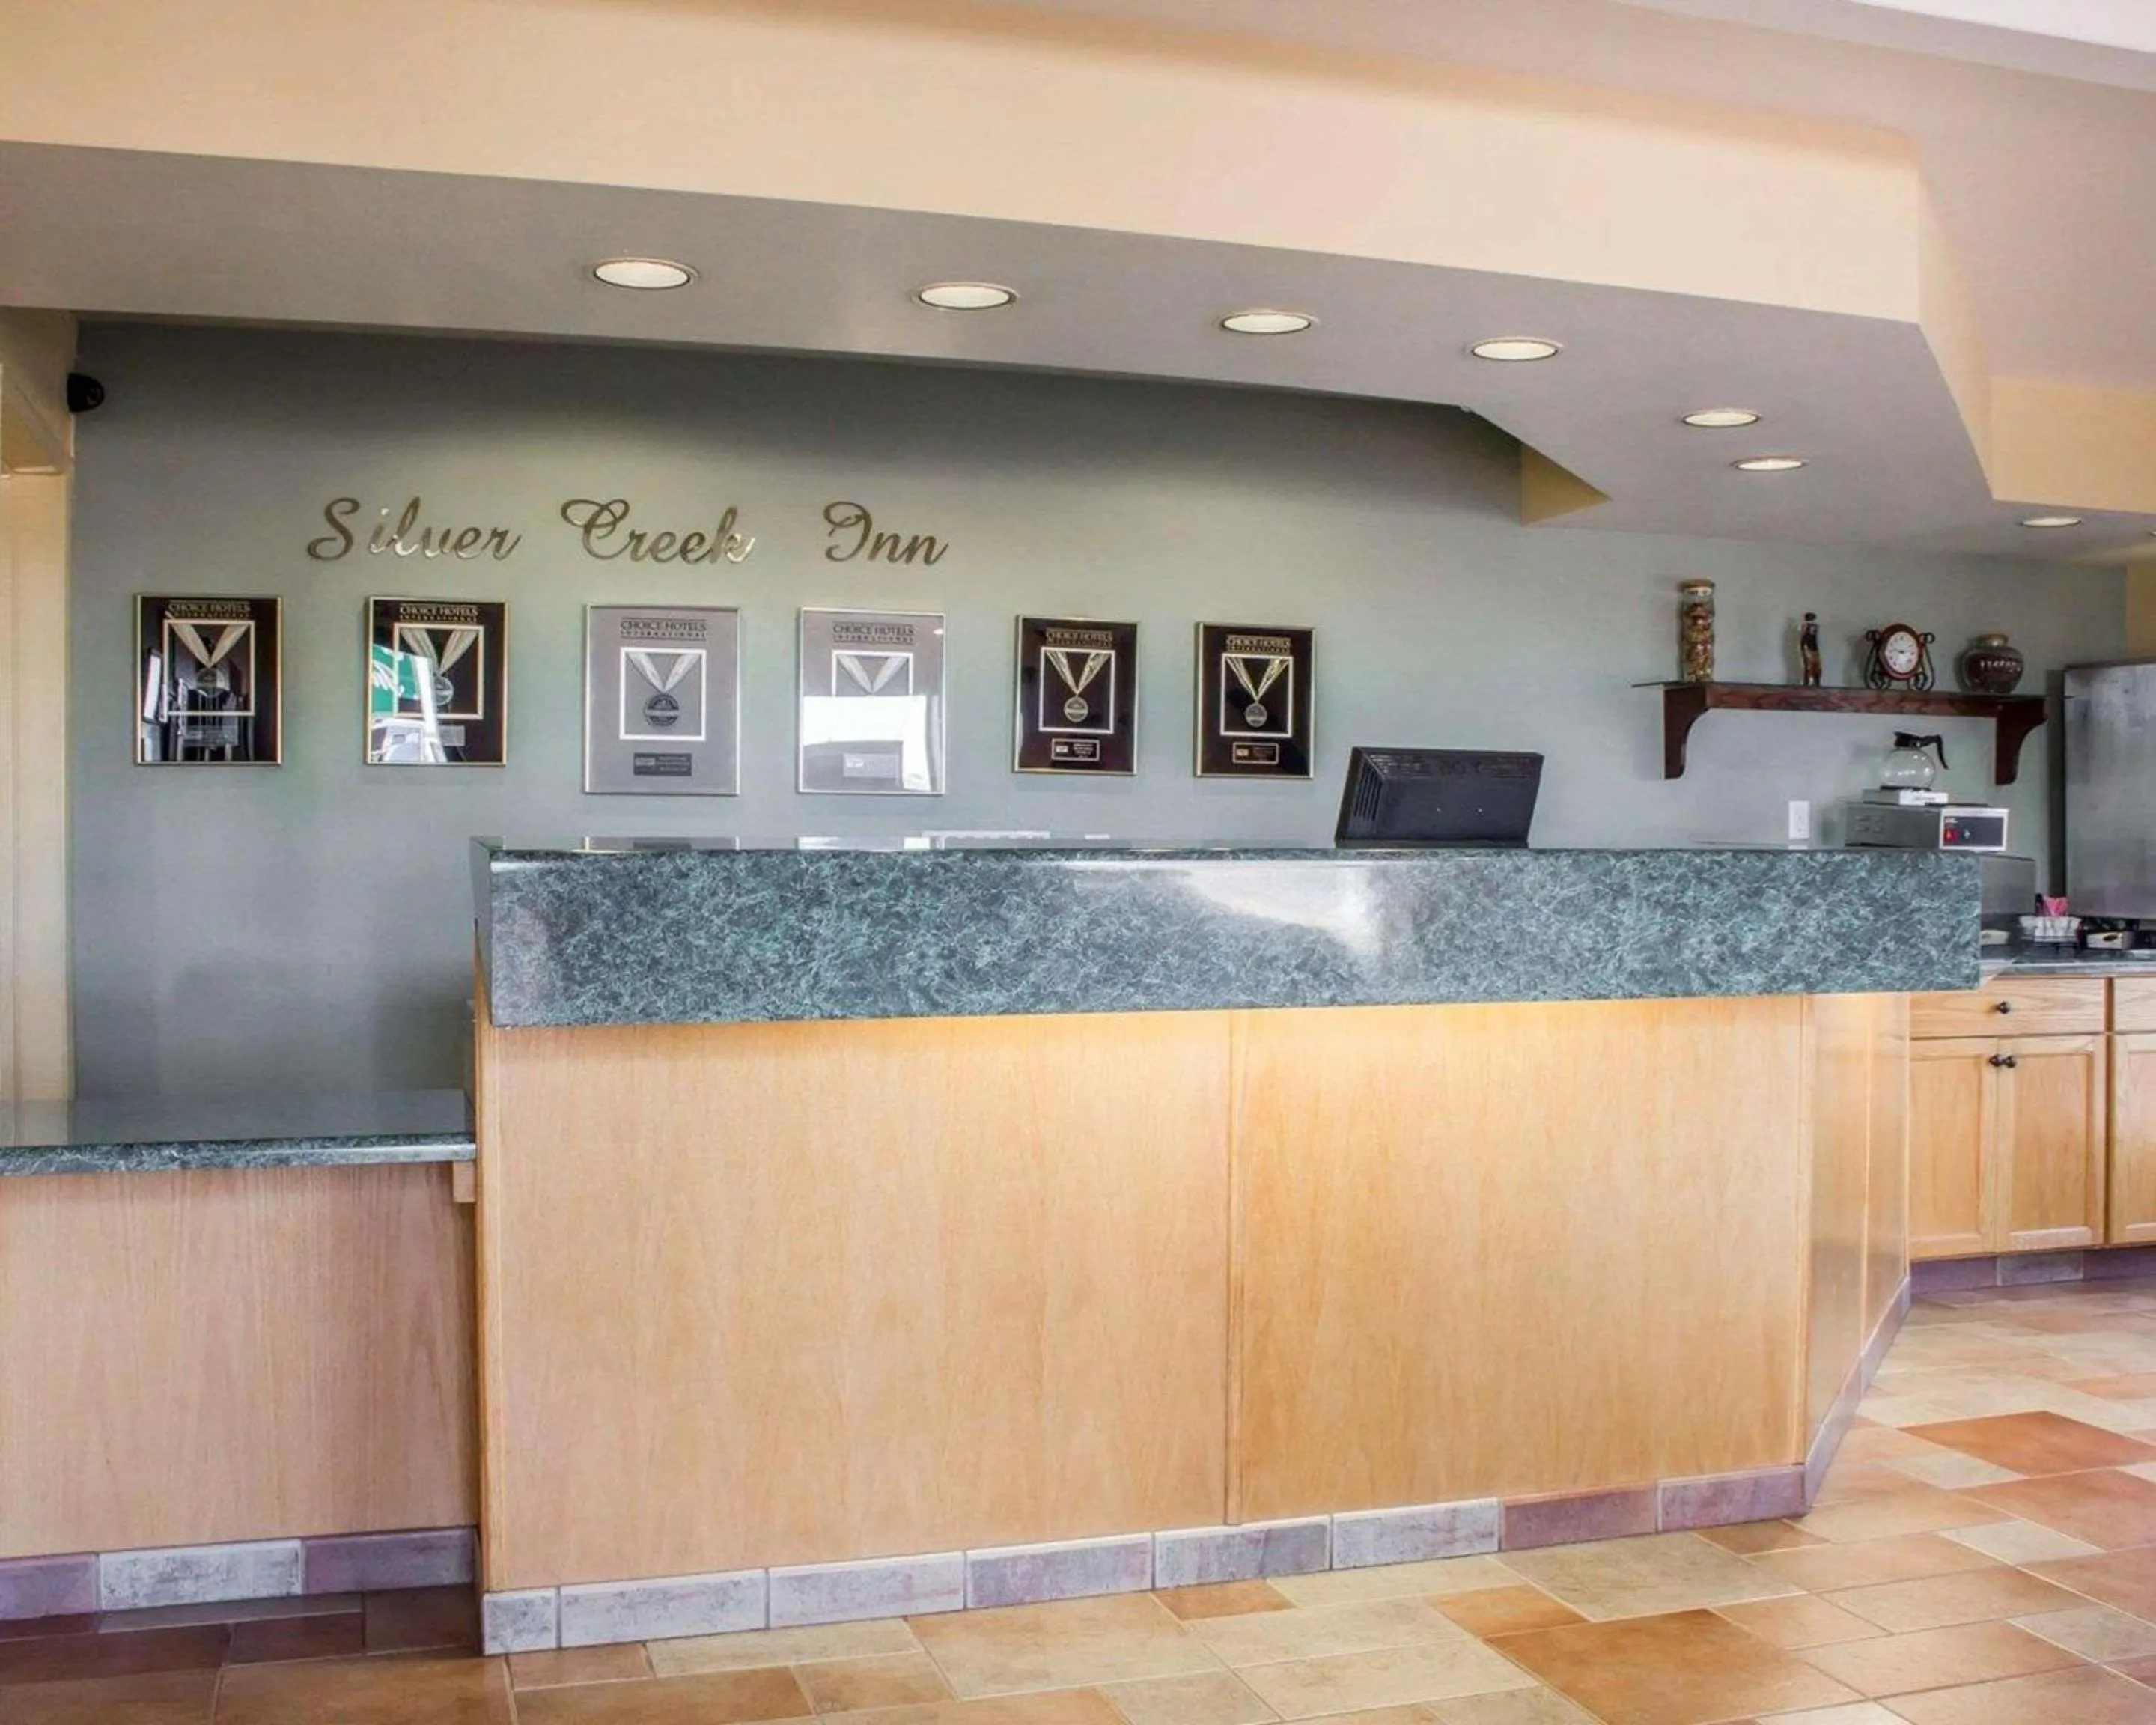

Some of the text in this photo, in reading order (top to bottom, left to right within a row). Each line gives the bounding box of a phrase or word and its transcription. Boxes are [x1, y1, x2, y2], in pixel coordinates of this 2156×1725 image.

[307, 496, 948, 567] Silver Creek Inn
[439, 606, 478, 616] HOTELS
[620, 620, 707, 631] CHOICE HOTELS
